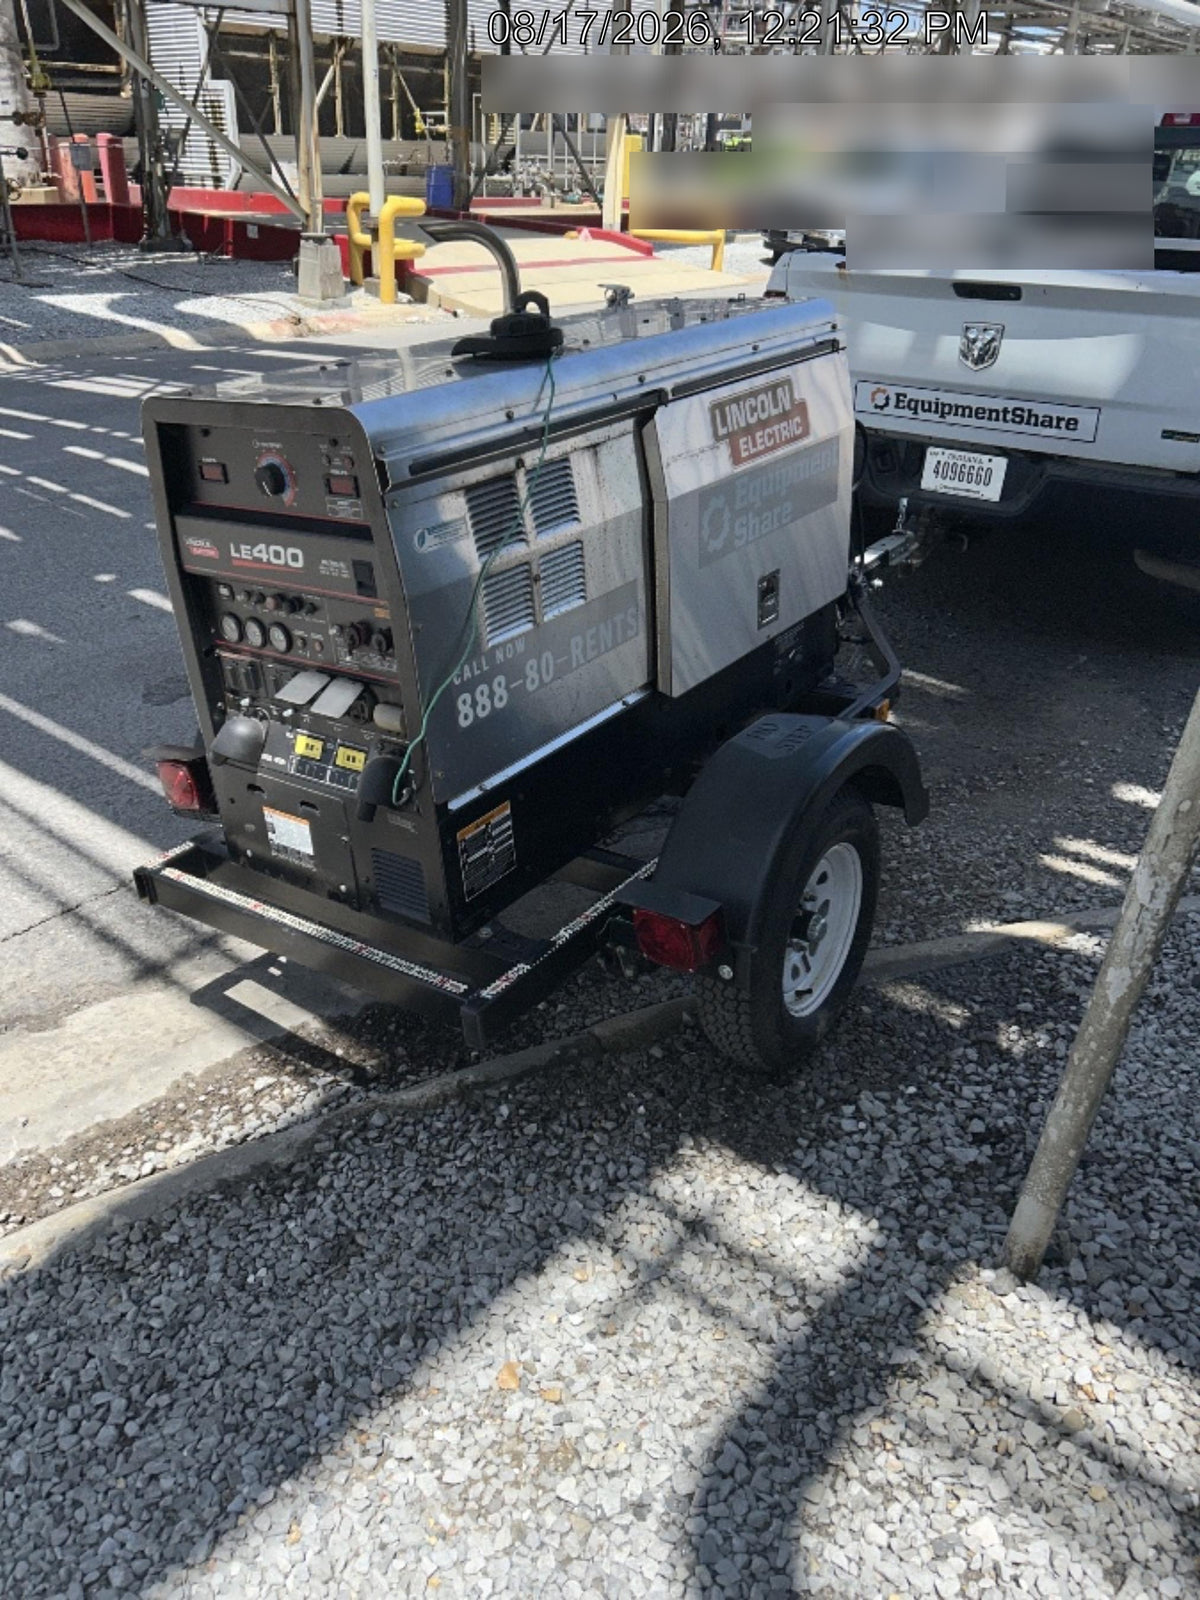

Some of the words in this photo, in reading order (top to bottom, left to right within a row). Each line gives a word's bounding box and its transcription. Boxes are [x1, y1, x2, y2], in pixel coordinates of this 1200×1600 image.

[715, 385, 791, 436] LINCOLN
[894, 392, 1079, 431] EquipmentShare
[740, 416, 803, 458] ELECTRIC
[734, 442, 839, 511] Equipment
[933, 460, 993, 487] 4096660
[733, 502, 793, 549] Share
[230, 543, 304, 568] LE400
[456, 607, 640, 728] 888-80-RENTS
[495, 637, 526, 663] NOW
